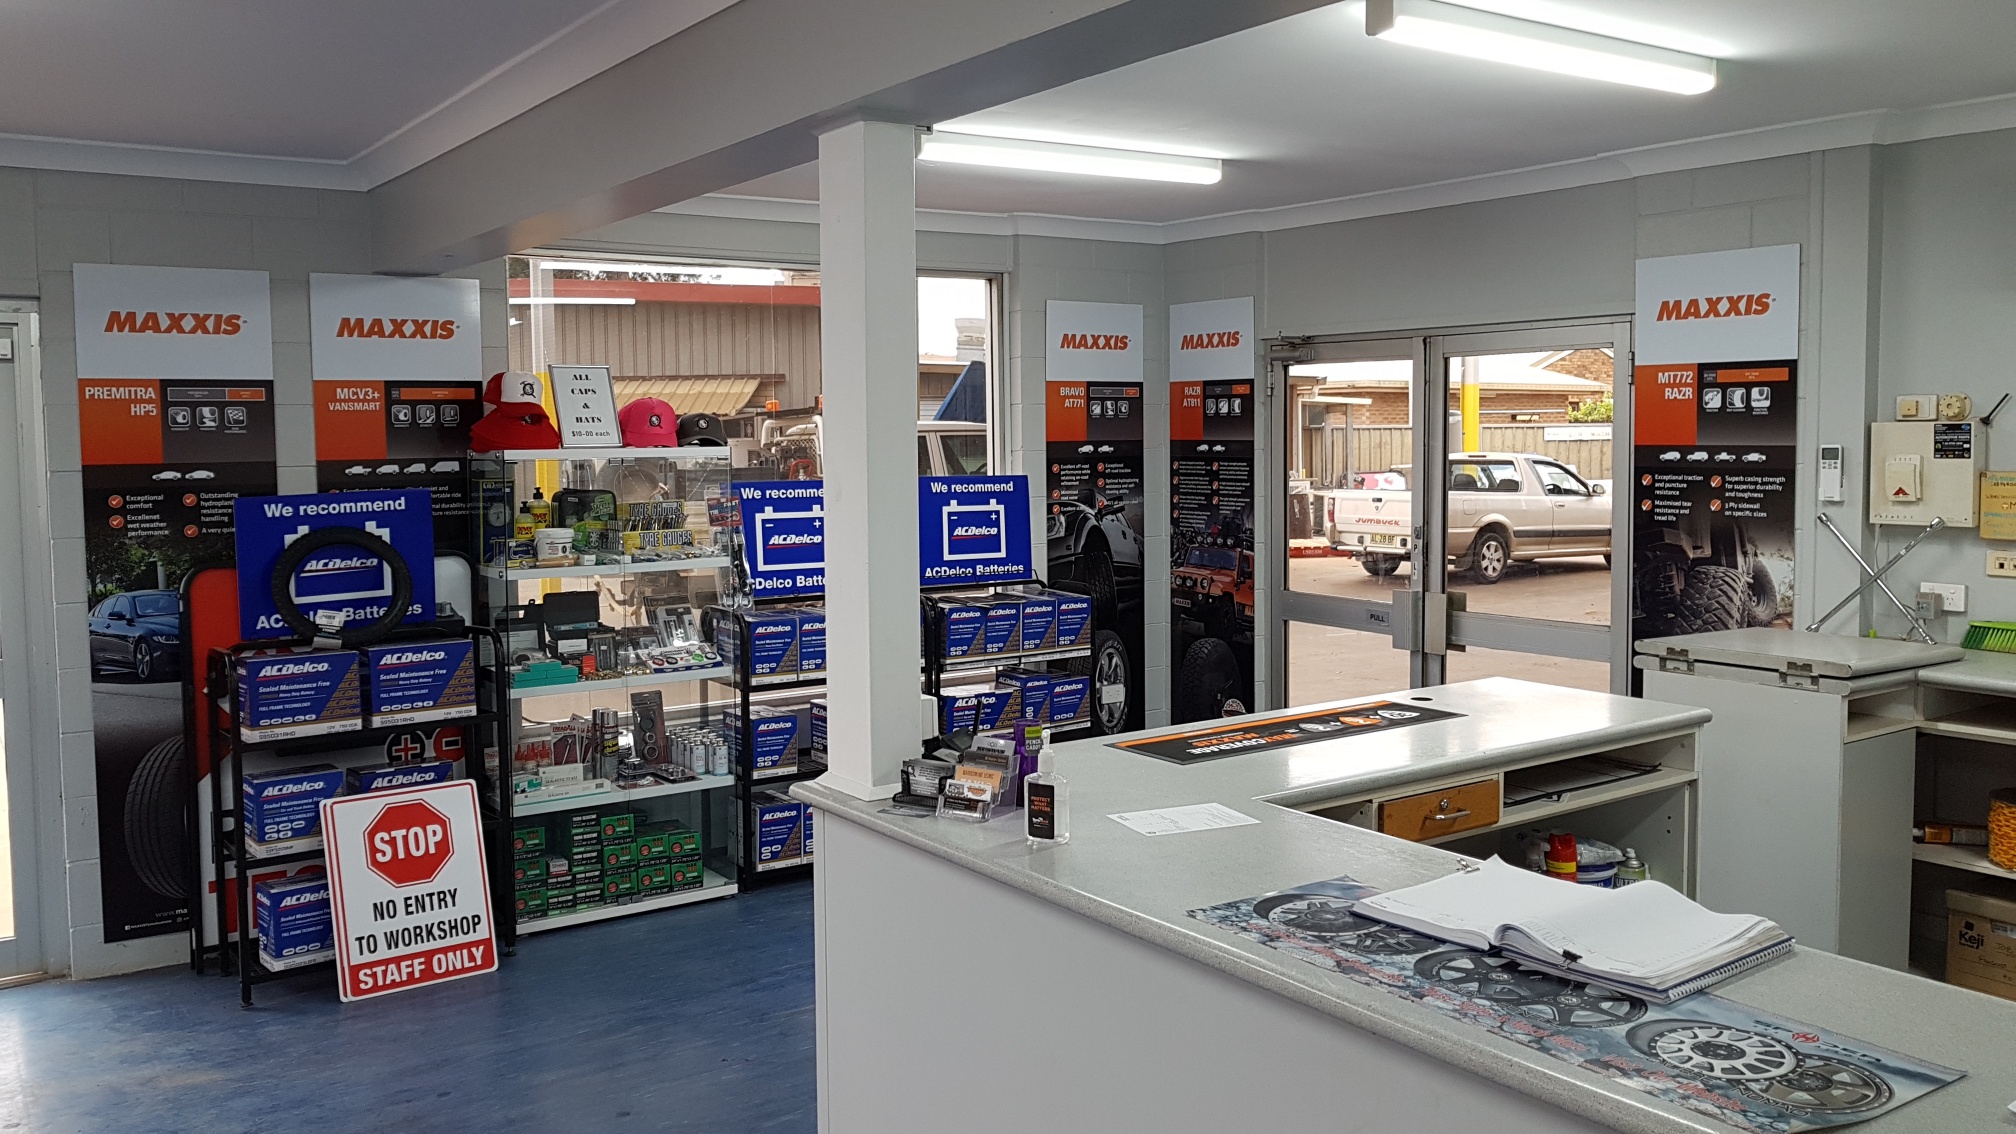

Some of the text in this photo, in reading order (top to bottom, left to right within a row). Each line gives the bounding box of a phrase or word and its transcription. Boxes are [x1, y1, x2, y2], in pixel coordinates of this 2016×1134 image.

[1656, 292, 1772, 322] MAXXIS
[104, 310, 243, 335] MAXXIS
[335, 317, 456, 340] MAXXIS
[1060, 333, 1129, 351] MAXXIS
[1180, 330, 1240, 350] MAXXIS
[1657, 371, 1694, 384] MT772
[84, 386, 156, 400] PREMITRA
[336, 387, 380, 400] MCV3+
[1060, 386, 1085, 397] BRAVO
[1184, 386, 1201, 396] RAZR
[1664, 388, 1693, 400] RAZR
[328, 402, 381, 411] VANSMART
[1064, 398, 1084, 408] AT771
[1182, 398, 1201, 408] AT811
[130, 403, 157, 416] HP5
[575, 416, 602, 424] HATS
[571, 430, 594, 438] $10-00
[1654, 474, 1684, 482] Exceptional
[1725, 475, 1786, 484] Superb casing strength
[930, 480, 1014, 493] We recommend
[1733, 483, 1756, 491] superior
[1756, 483, 1783, 491] durability
[126, 494, 164, 502] Exceptional
[199, 492, 239, 500] Outstanding
[741, 487, 825, 499] We recomme
[1735, 491, 1764, 499] toughness
[263, 496, 406, 518] We recommend
[629, 503, 650, 517] TYRE
[1729, 502, 1738, 510] Ply
[126, 513, 160, 521] Excellenet
[200, 514, 229, 522] handling
[1732, 510, 1753, 518] specific
[140, 520, 167, 528] weather
[1355, 517, 1400, 526] JUMBUCK
[127, 528, 169, 537] performance
[207, 527, 222, 535] very
[222, 526, 236, 535] quie
[953, 525, 998, 536] ACDelco
[639, 530, 693, 548] TYRE GAUGES
[768, 533, 823, 545] ACDelco
[303, 556, 379, 572] ACDelco
[924, 563, 1025, 578] ACDelco Batteries
[1024, 605, 1053, 614] ACDelco
[1059, 602, 1088, 610] ACDelco
[950, 610, 981, 619] ACDelco
[987, 608, 1017, 616] ACDelco
[1369, 613, 1386, 623] PULL
[755, 625, 791, 634] ACDelco
[378, 650, 446, 665] ACDelco
[257, 661, 329, 678] ACDelco
[379, 673, 399, 681] Sealed
[399, 670, 434, 679] Maintenance
[258, 680, 331, 693] Sealed Maintenance Free
[998, 676, 1021, 687] ACDelco
[1053, 683, 1083, 693] ACDelco
[757, 721, 793, 731] ACDelco
[370, 770, 435, 789] ACDelco
[261, 781, 324, 798] ACDelco
[263, 799, 313, 810] Sealed Maintenance
[762, 810, 797, 821] ACDelco
[373, 823, 444, 864] STOP
[279, 889, 331, 908] ACDelc
[372, 887, 459, 922] NO ENTRY
[354, 914, 482, 957] TO WORKSHOP
[1958, 929, 1985, 950] Keji
[358, 945, 485, 990] STAFF ONLY
[1730, 1084, 1810, 1118] NOMAD
